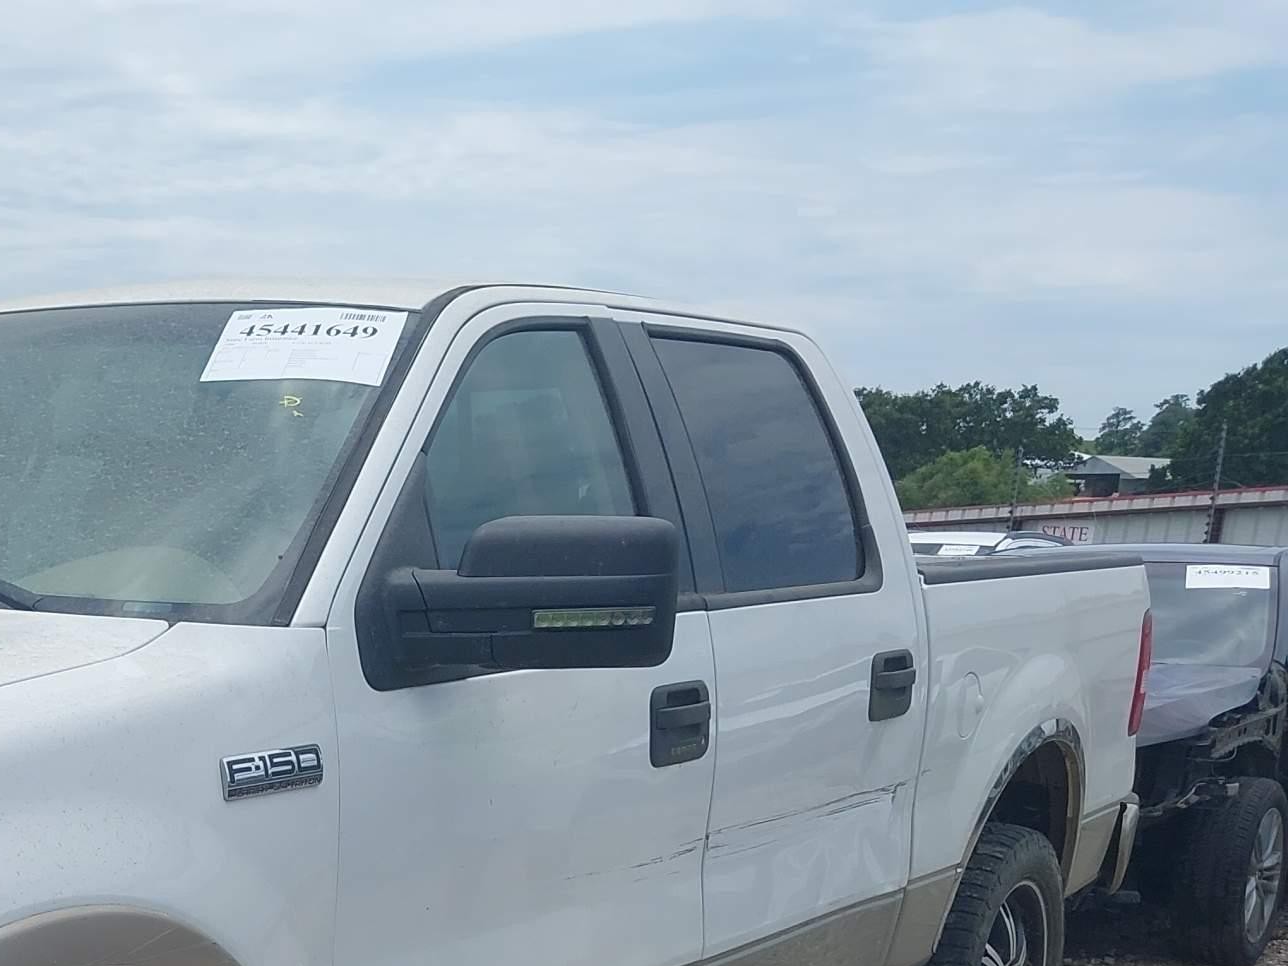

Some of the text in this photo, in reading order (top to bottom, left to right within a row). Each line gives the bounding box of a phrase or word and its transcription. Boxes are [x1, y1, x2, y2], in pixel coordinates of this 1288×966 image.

[239, 323, 379, 339] 45441649
[1041, 525, 1089, 542] STATE
[226, 748, 321, 784] F-150
